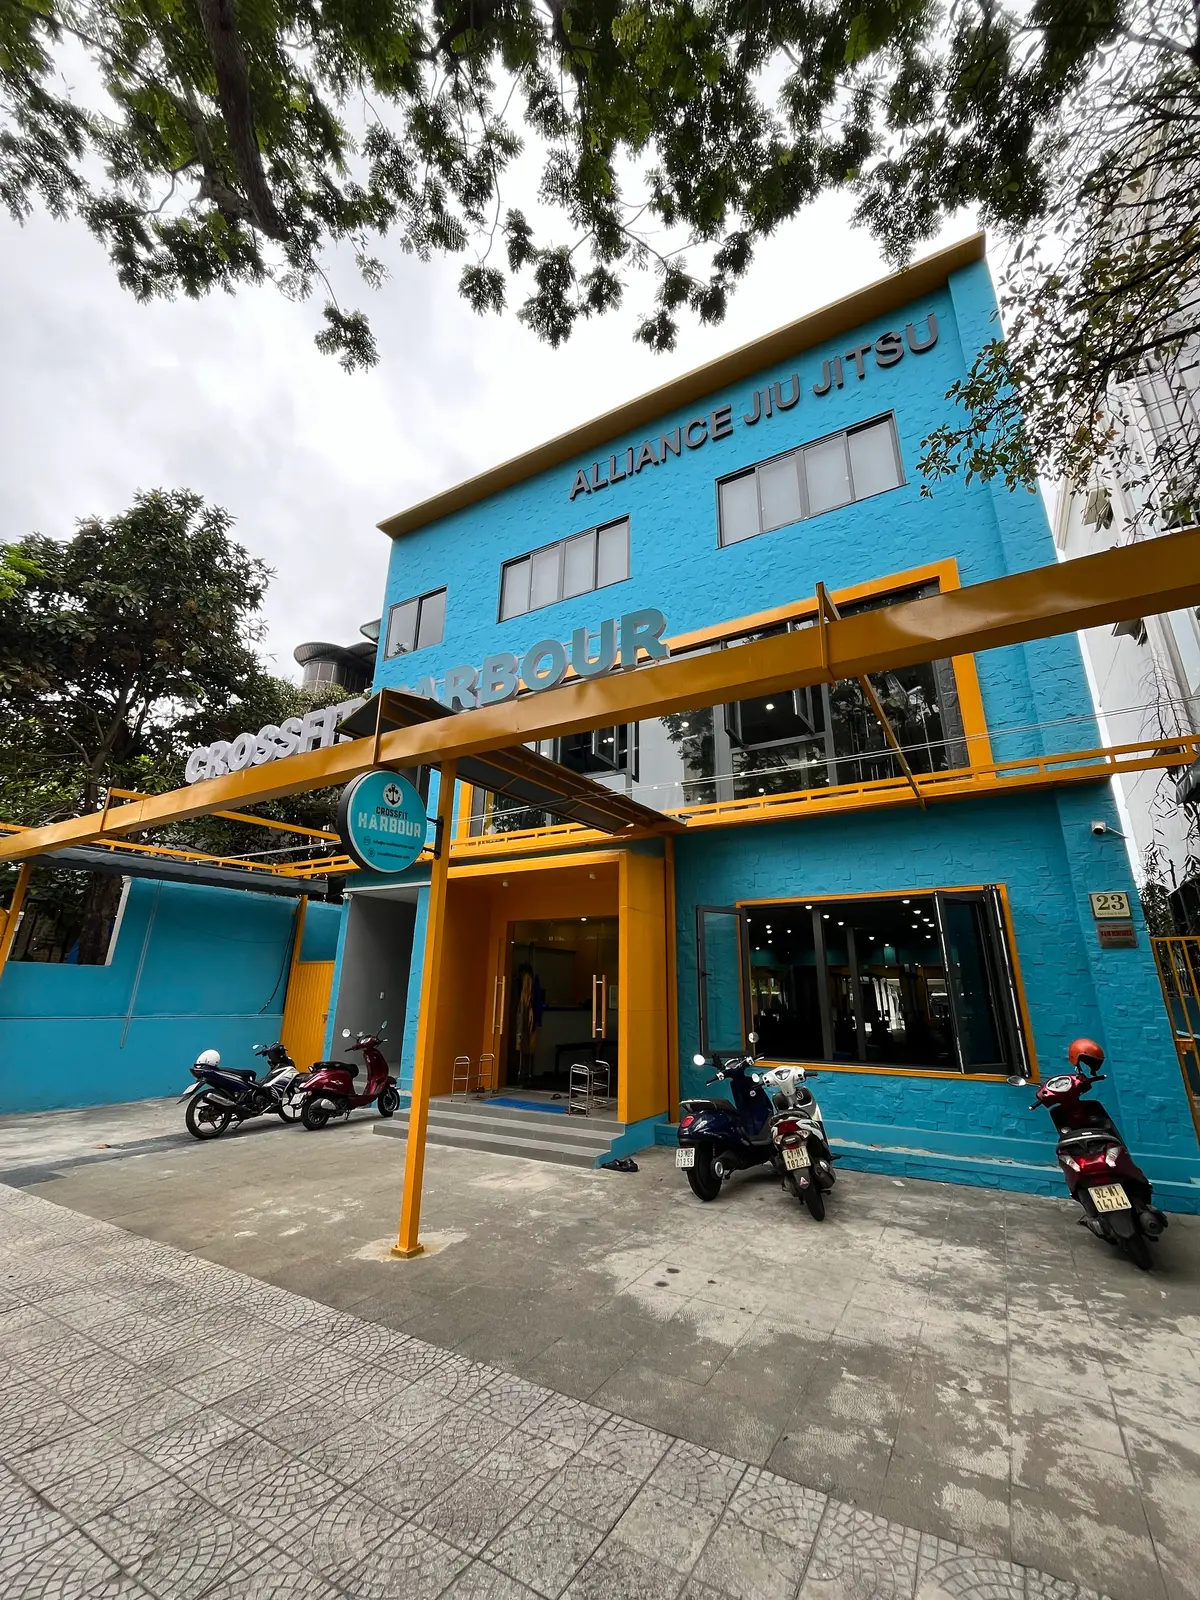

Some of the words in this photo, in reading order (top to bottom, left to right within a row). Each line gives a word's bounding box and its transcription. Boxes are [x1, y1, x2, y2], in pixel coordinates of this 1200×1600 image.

[569, 404, 733, 500] ALLIANCE
[743, 374, 800, 426] JIU
[812, 312, 939, 396] JITSU
[396, 608, 670, 709] ARBOUR
[358, 812, 422, 838] HARBOUR
[376, 806, 409, 820] CROSSFIT
[1096, 895, 1125, 911] 23
